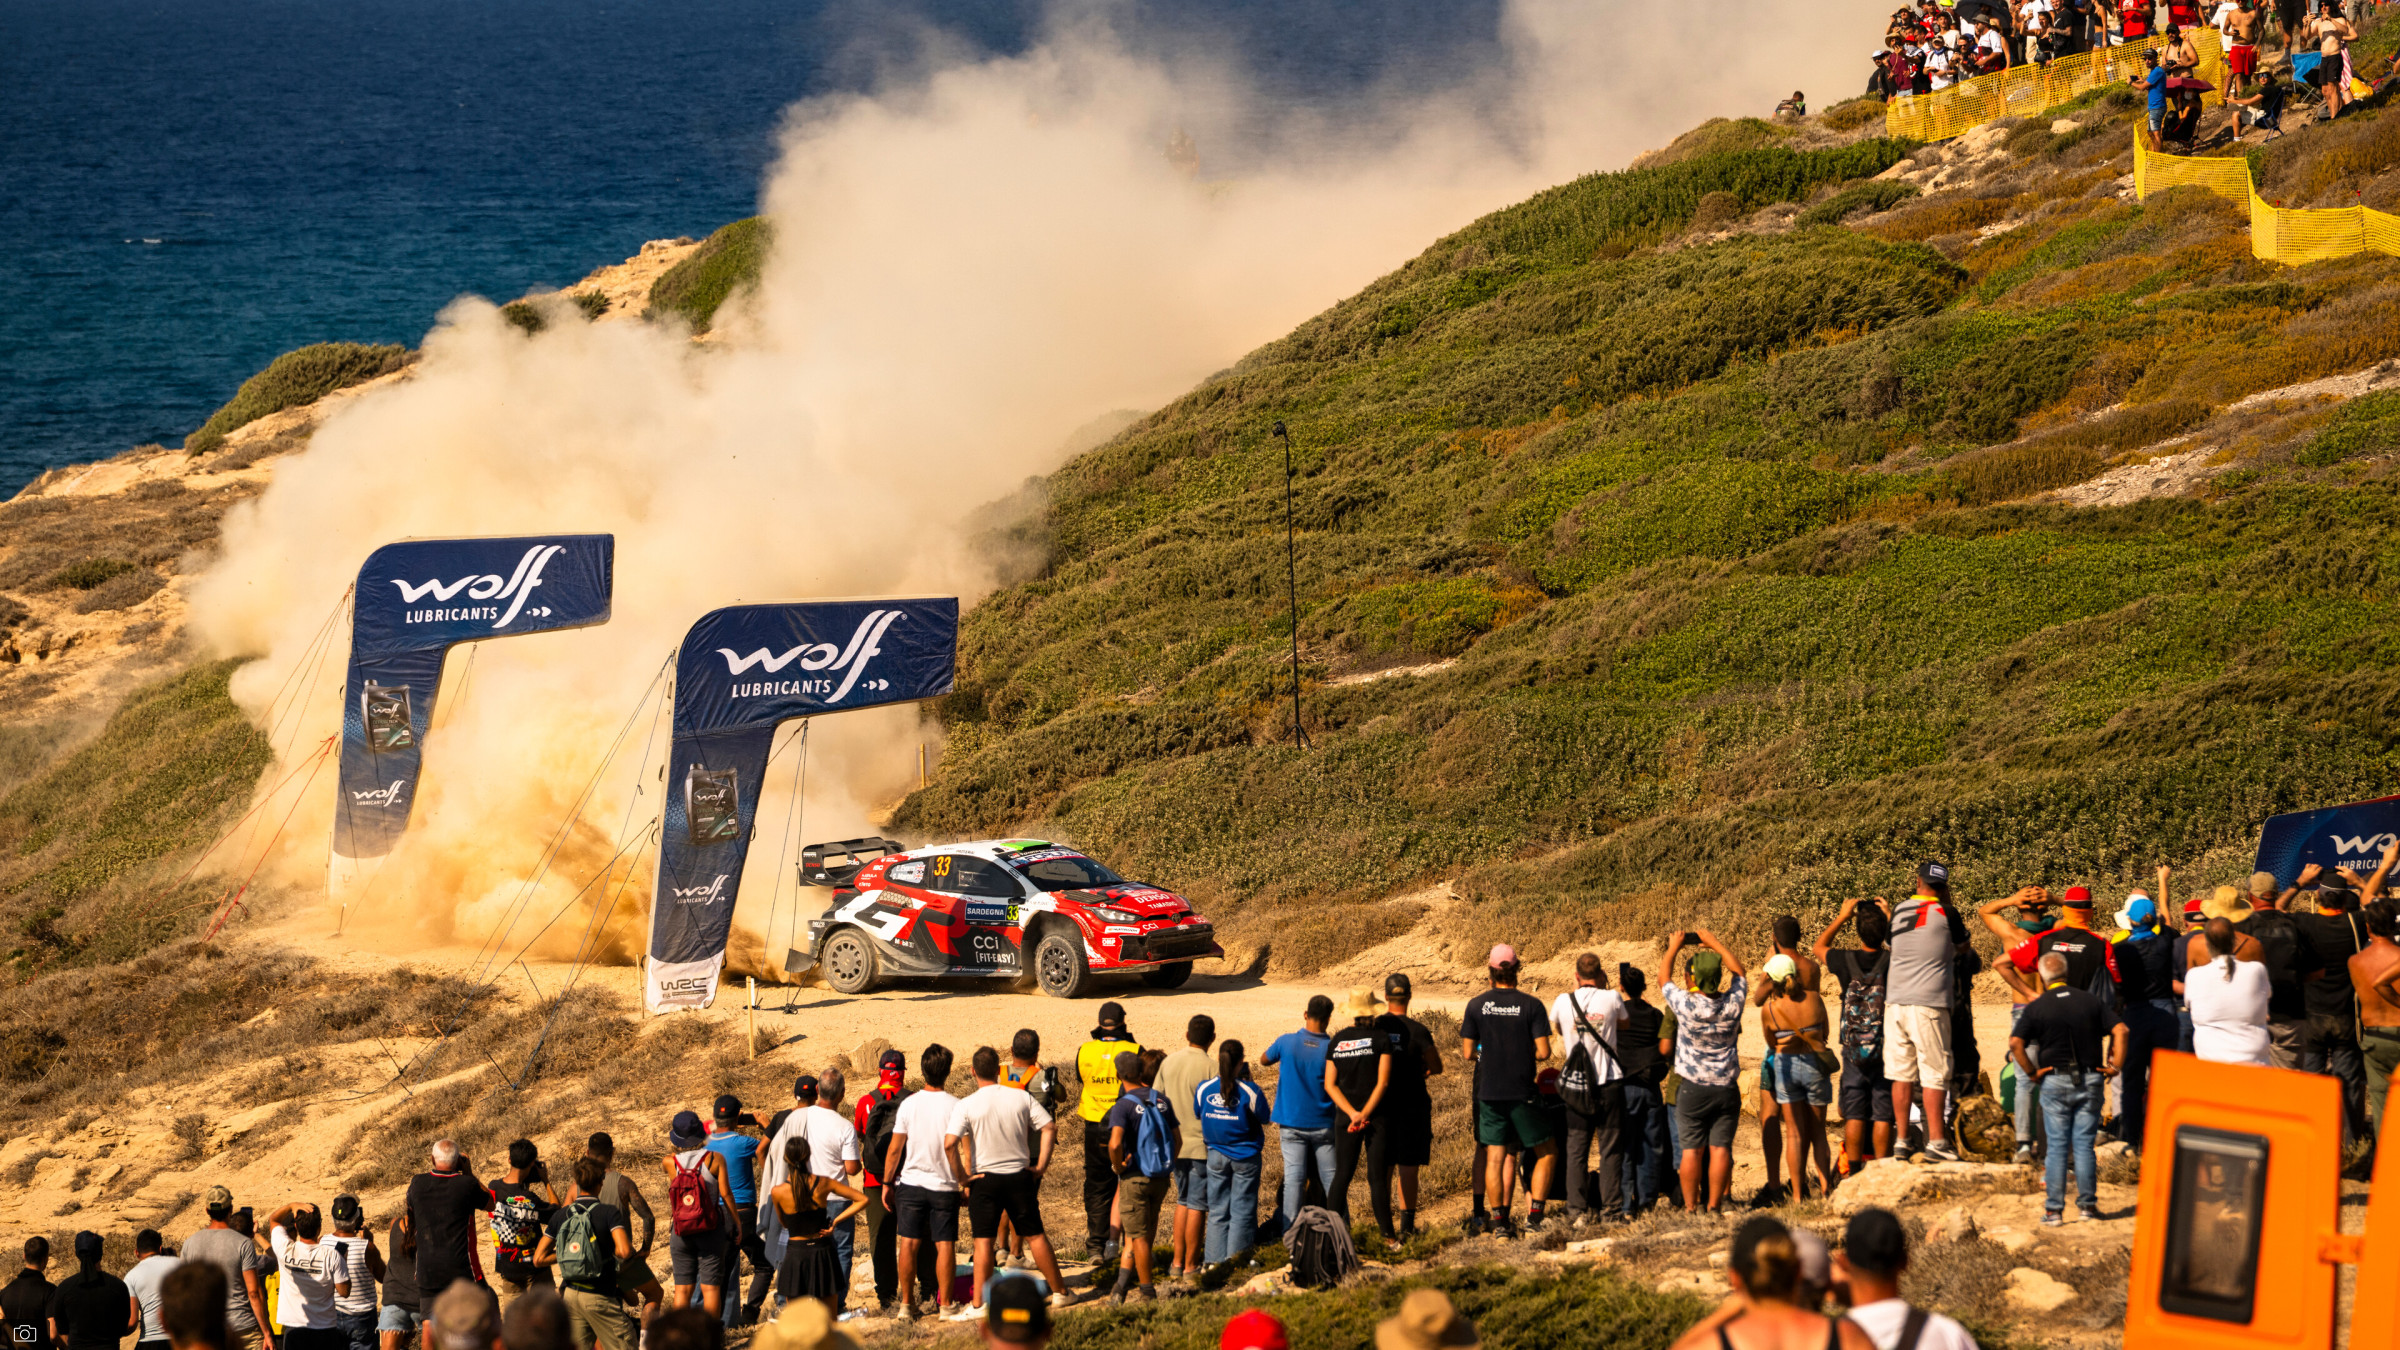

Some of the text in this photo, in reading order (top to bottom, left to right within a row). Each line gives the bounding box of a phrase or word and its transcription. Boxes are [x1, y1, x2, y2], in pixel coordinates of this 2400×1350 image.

[390, 545, 562, 628] wolf
[406, 607, 498, 624] LUBRICANTS
[715, 609, 903, 704] wolf
[732, 679, 831, 698] LUBRICANTS
[934, 856, 952, 876] 33
[2337, 860, 2382, 870] LUBRICA
[1135, 894, 1170, 903] DENSO
[967, 907, 1004, 916] SARDEGNA
[1006, 905, 1019, 921] 33
[661, 978, 707, 991] WRC
